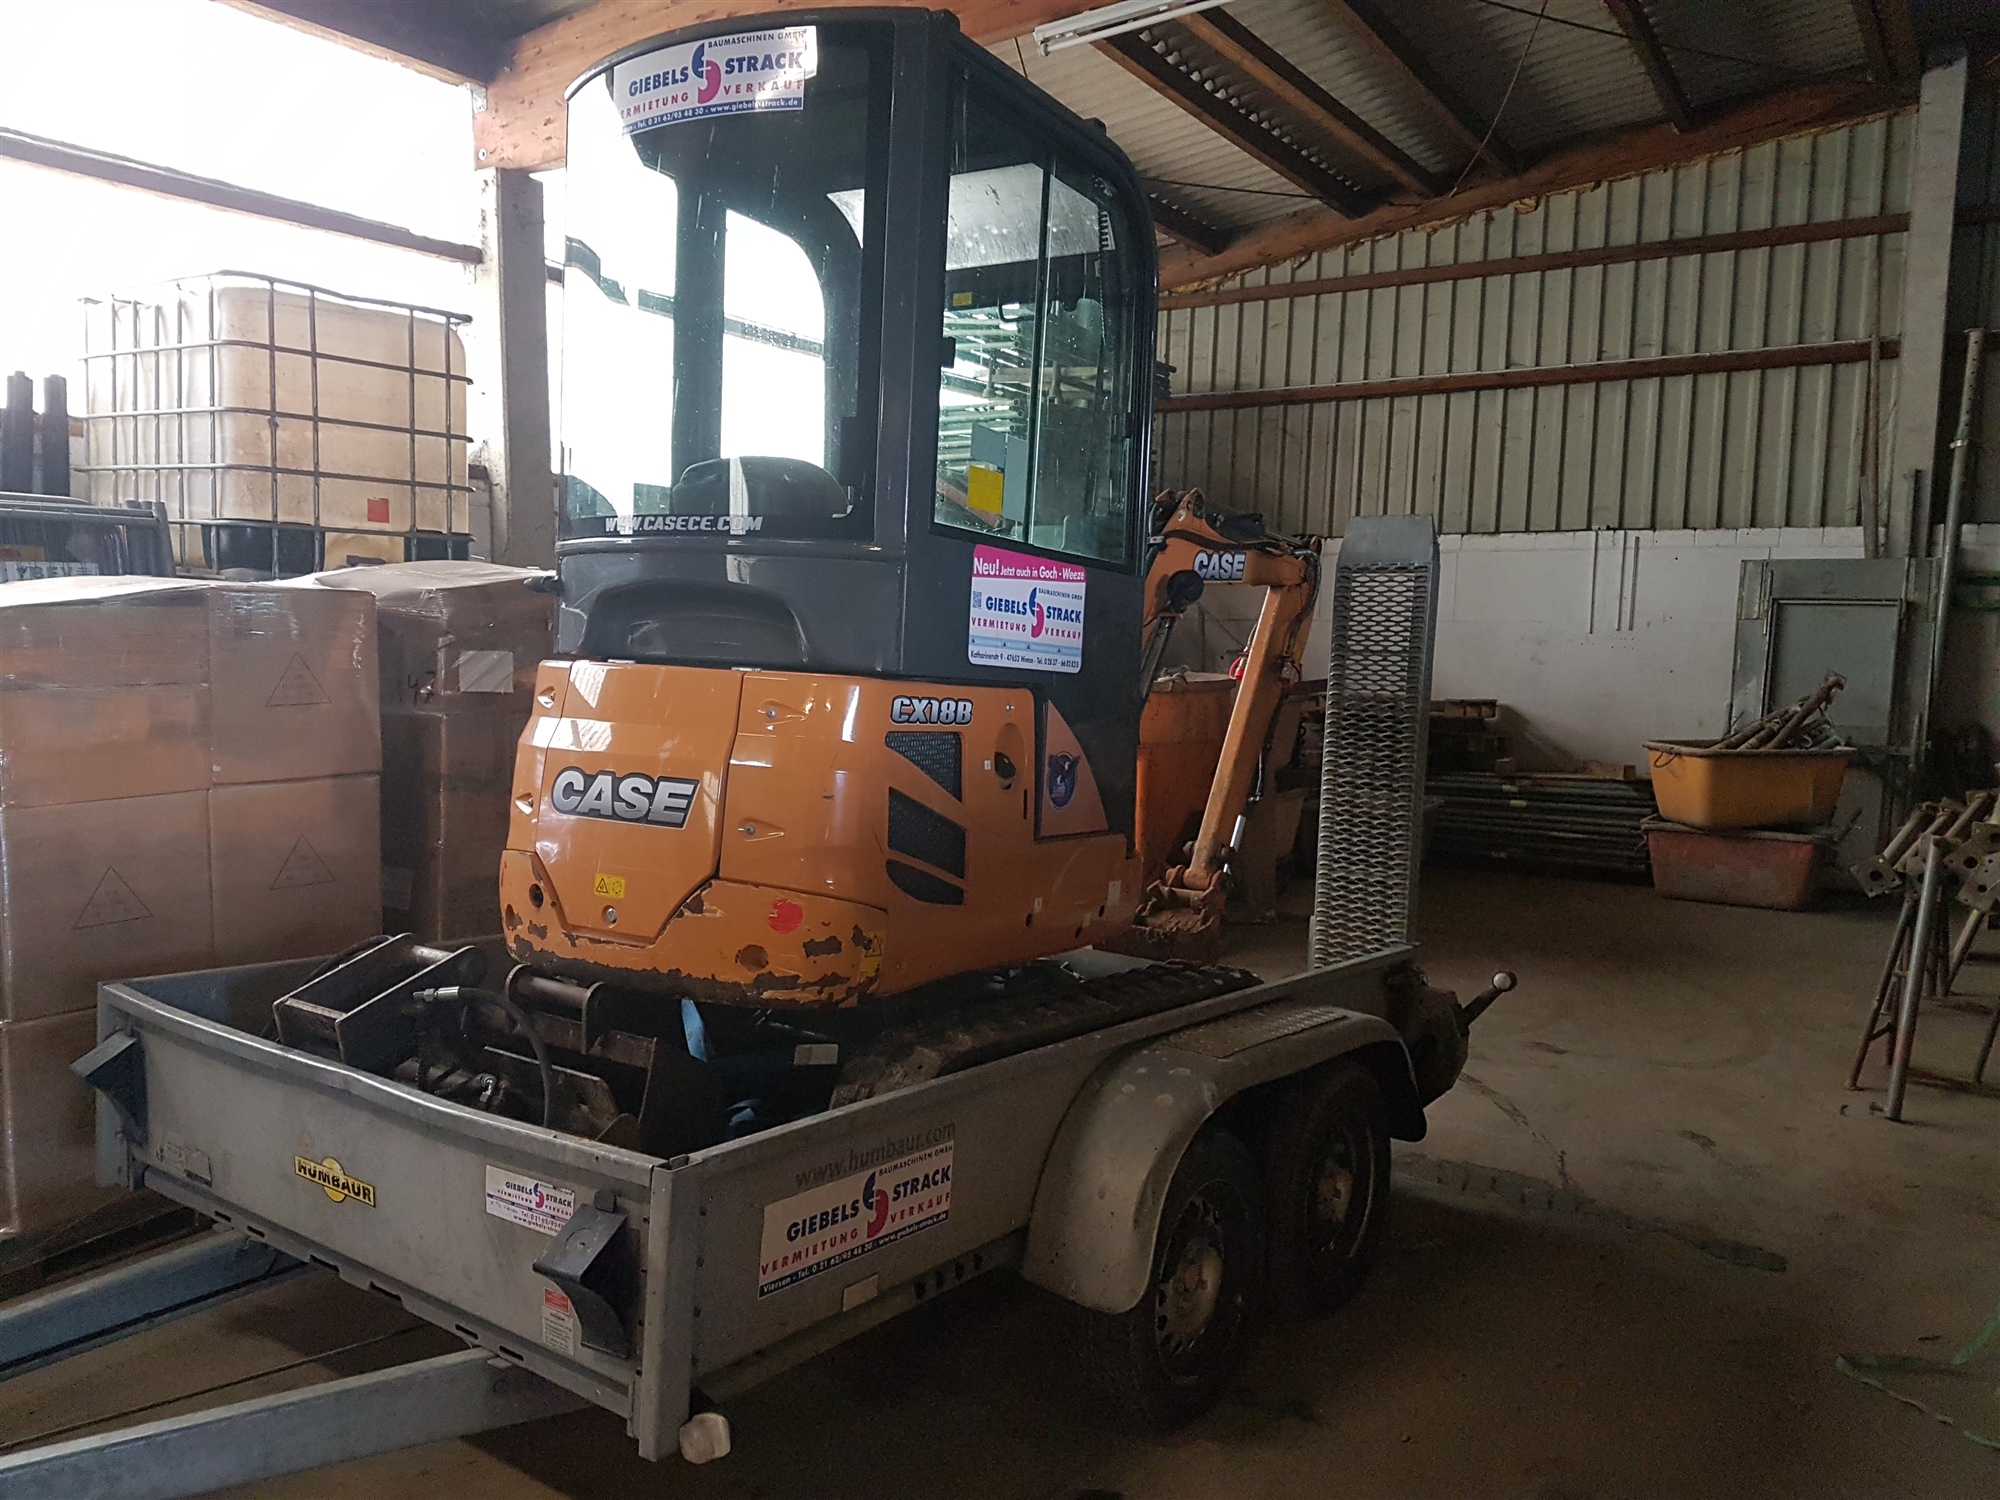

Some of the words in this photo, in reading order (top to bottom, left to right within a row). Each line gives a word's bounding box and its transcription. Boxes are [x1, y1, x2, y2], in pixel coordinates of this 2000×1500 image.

[708, 32, 775, 48] BAUMASCHINEN
[628, 66, 689, 97] GIEBELS
[724, 51, 804, 75] STRACK
[620, 92, 689, 120] ERMIETUNG
[723, 79, 804, 96] VERKAUF
[605, 516, 763, 532] WWW.CASECE.COM
[973, 557, 999, 576] Neu!
[1000, 565, 1016, 577] Jetzt
[1016, 567, 1031, 577] auch
[1032, 567, 1038, 578] in
[1039, 566, 1058, 580] Goch
[1062, 568, 1085, 580] Weeze
[1193, 551, 1246, 580] CASE
[985, 596, 1027, 616] GIEBELS
[1046, 606, 1082, 624] STRACK
[971, 617, 1027, 632] VERMIETUNG
[1044, 627, 1081, 640] VERKAUF
[892, 697, 973, 725] CX18B
[552, 769, 695, 824] CASE
[795, 1121, 957, 1189] www.humbaur.com
[878, 1152, 933, 1177] BAUMASCHINEN
[297, 1159, 372, 1202] HUMBAUR
[505, 1181, 533, 1196] GIEBELS
[546, 1194, 572, 1208] STRACK
[786, 1198, 860, 1242] GIEBELS
[892, 1164, 952, 1202] STRACK
[761, 1228, 859, 1276] VERMIETUNG
[890, 1192, 950, 1223] VERKAUF
[763, 1276, 791, 1293] Viersen
[797, 1267, 810, 1278] Tel.
